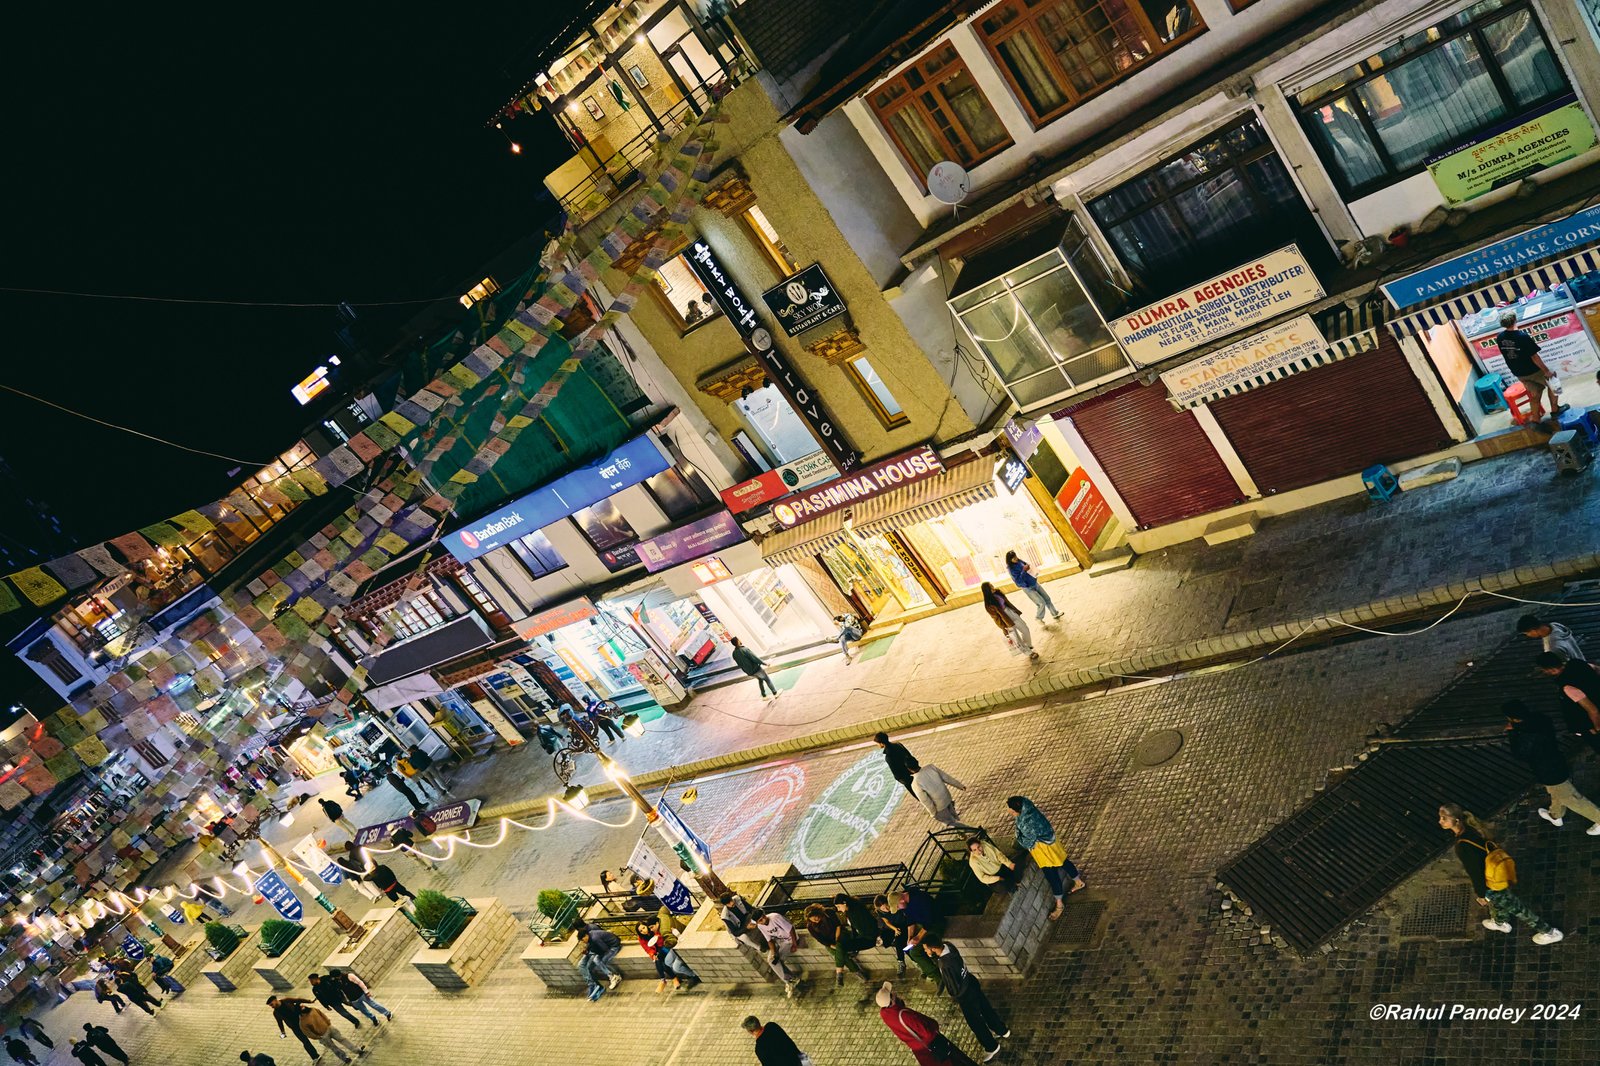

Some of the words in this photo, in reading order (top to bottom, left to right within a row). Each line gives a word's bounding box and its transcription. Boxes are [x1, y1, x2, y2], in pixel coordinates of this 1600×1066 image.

[1457, 166, 1477, 180] M/s
[1478, 151, 1514, 171] DUMRA
[1517, 127, 1570, 154] AGENCIES
[1416, 262, 1490, 296] PAMPOSH
[1493, 241, 1549, 268] SHAKE
[1552, 221, 1600, 246] CORN
[704, 258, 726, 288] SKY
[724, 286, 748, 316] WOK
[1239, 263, 1306, 297] DISTRIBUTER)
[792, 308, 806, 320] SKY
[805, 299, 824, 313] WOK
[1127, 296, 1190, 330] DUMRA
[1194, 262, 1267, 303] AGENCIES
[788, 313, 821, 334] RESTAURANT
[1158, 330, 1170, 339] 1st
[1170, 320, 1194, 334] FLOOR
[1197, 305, 1232, 324] MENGON
[1233, 288, 1272, 309] COMPLEX
[1159, 333, 1183, 348] NEAR
[1204, 315, 1229, 330] MAIN
[1234, 298, 1272, 318] MARKET
[1272, 290, 1291, 302] LEH
[1240, 311, 1262, 323] 194101
[1532, 315, 1568, 333] SHAKE
[1177, 389, 1191, 397] DEALS
[1268, 345, 1301, 361] DECORATION
[1300, 338, 1318, 348] ITEMS
[1180, 353, 1249, 389] STANZIN
[1253, 332, 1301, 360] ARTS
[1202, 381, 1226, 393] COMPLEX
[1225, 375, 1241, 384] SHOP
[1251, 366, 1265, 374] NEAR
[765, 350, 842, 453] Travel
[796, 460, 817, 474] STORK
[841, 451, 855, 470] 24x7
[789, 474, 878, 518] PASHMINA
[874, 450, 941, 487] HOUSE
[472, 521, 507, 541] Bandhan
[500, 511, 524, 528] Bank
[900, 551, 921, 578] HOUSE
[369, 731, 381, 743] ATM
[819, 802, 844, 820] STORK
[840, 811, 870, 832] CARGO
[369, 827, 380, 842] SBI
